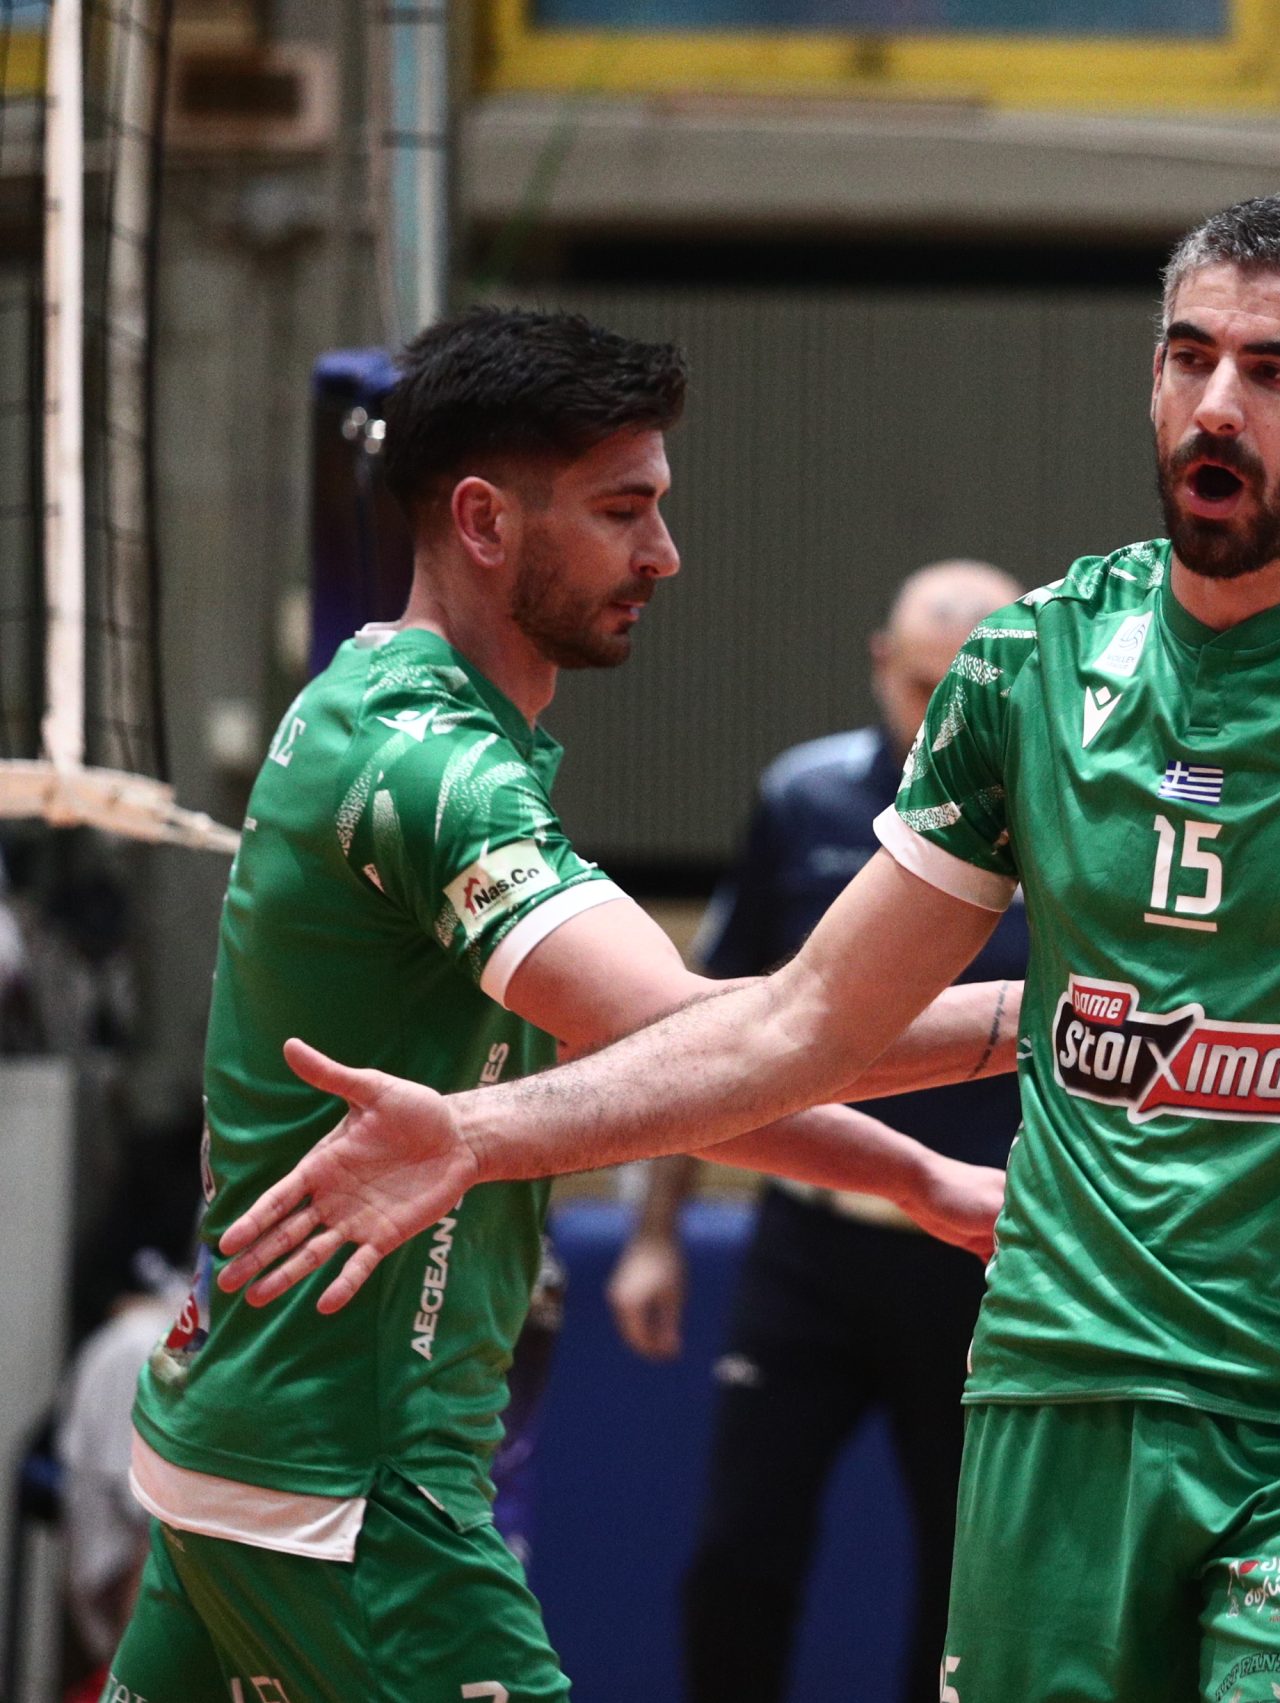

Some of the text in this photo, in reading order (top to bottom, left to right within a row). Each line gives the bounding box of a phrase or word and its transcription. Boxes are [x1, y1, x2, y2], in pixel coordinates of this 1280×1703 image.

[473, 867, 540, 909] Nas.Co
[1150, 814, 1223, 915] 15
[411, 1216, 458, 1361] AEGEAN
